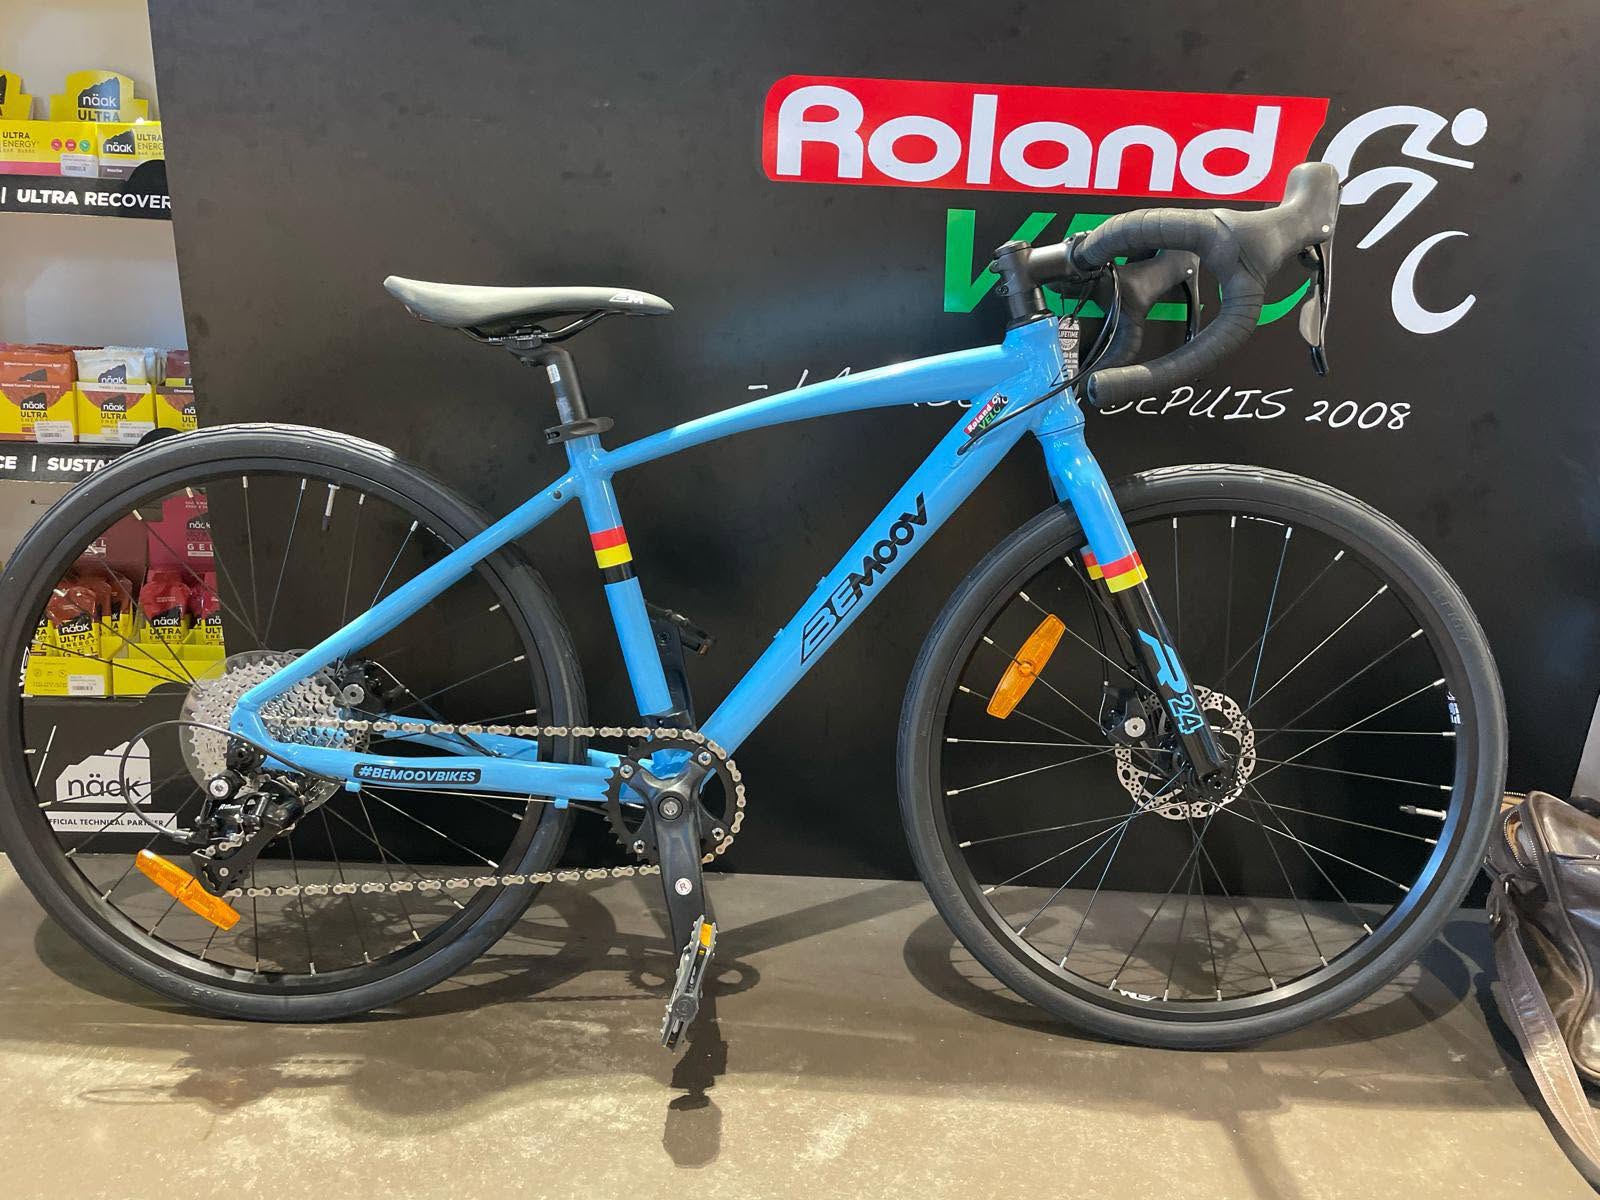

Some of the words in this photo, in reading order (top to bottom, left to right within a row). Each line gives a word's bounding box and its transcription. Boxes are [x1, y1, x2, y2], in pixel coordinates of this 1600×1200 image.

[82, 93, 117, 107] näak
[78, 109, 121, 122] ULTRA
[2, 131, 30, 139] ULTRA
[776, 84, 1281, 194] Roland
[105, 142, 133, 153] näak
[17, 188, 79, 205] ULTRA
[22, 401, 46, 410] näak
[103, 402, 125, 411] näak
[100, 412, 128, 420] ULTRA
[1305, 400, 1411, 430] 2008
[46, 457, 114, 472] SUSTA
[800, 491, 928, 666] BEMOOV
[153, 616, 180, 626] näak
[59, 632, 95, 643] ULTRA
[358, 765, 476, 782] #BEMOOVBIKES
[68, 773, 142, 797] näak
[50, 818, 77, 826] FFICIAL
[127, 819, 164, 827] PARTER
